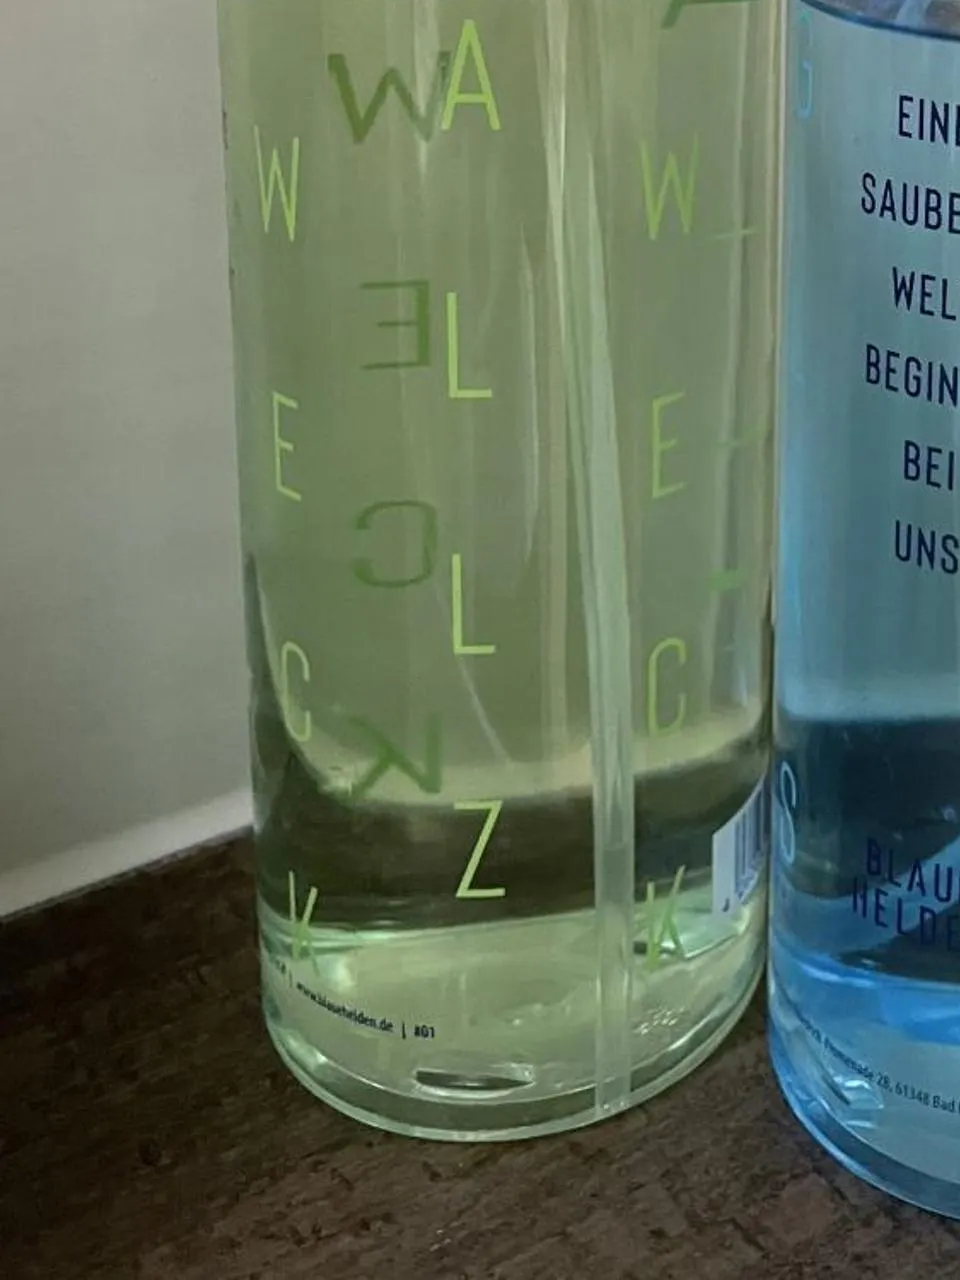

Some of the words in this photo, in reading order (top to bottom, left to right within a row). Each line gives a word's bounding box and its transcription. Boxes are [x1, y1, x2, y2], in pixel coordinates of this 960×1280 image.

[904, 439, 955, 491] BEI
[895, 520, 960, 574] UNS
[932, 1094, 956, 1113] Bad
